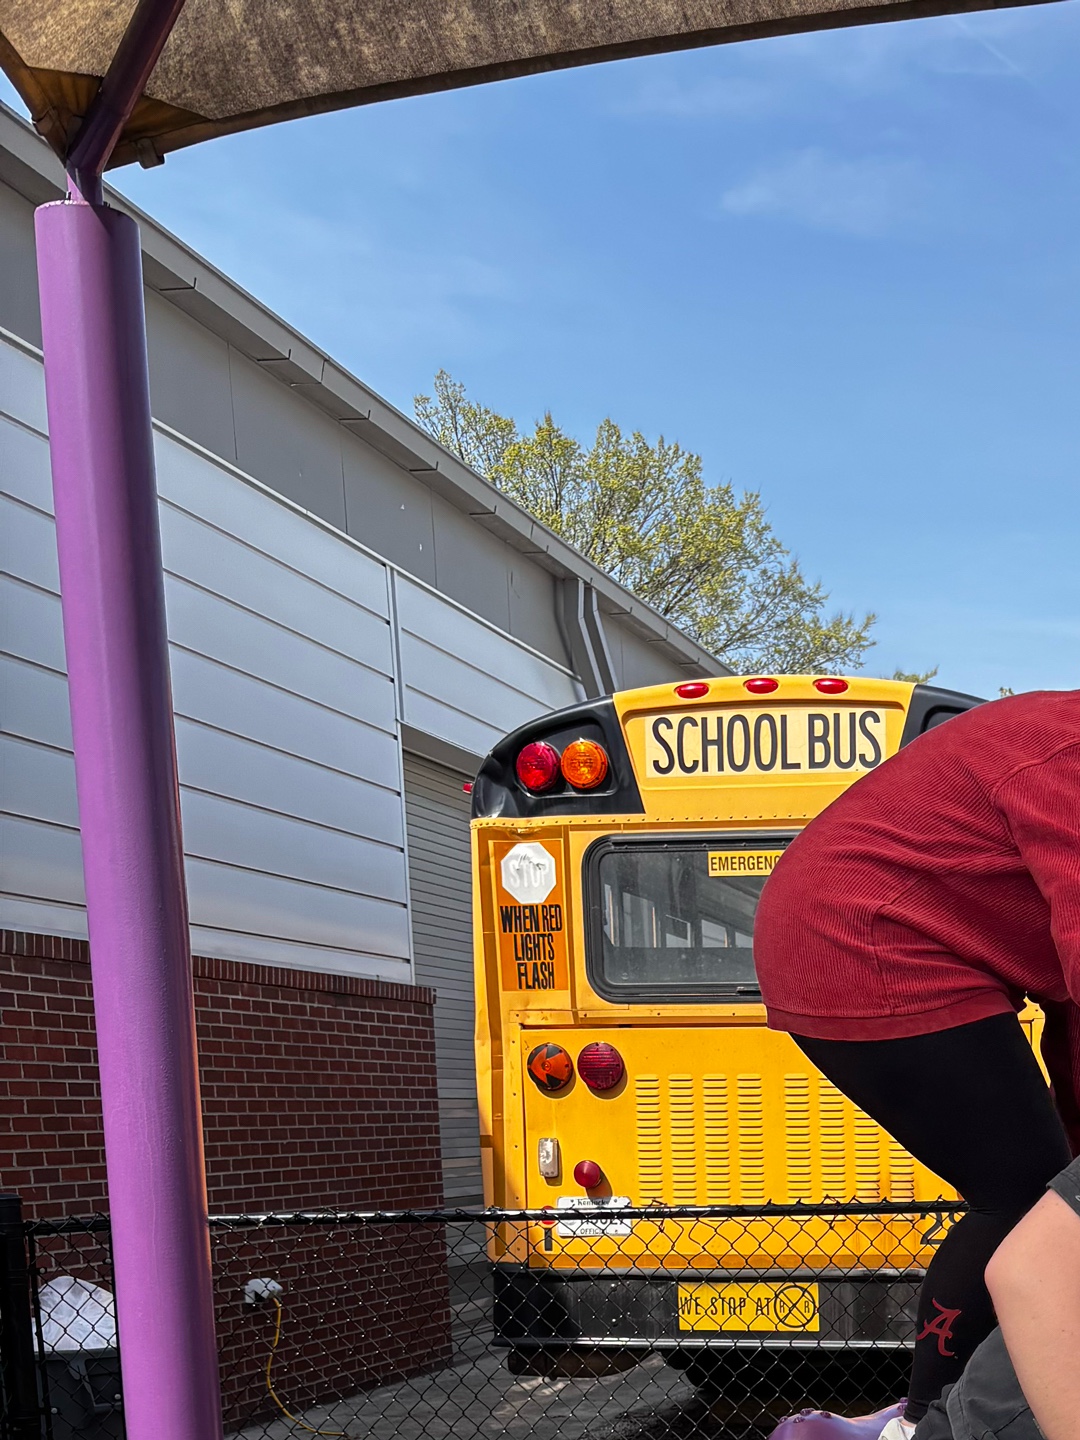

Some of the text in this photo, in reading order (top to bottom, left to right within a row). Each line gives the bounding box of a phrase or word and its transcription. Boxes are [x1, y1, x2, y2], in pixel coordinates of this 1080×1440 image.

[652, 710, 882, 775] SCHOOL BUS
[710, 854, 782, 871] EMERGEN
[500, 904, 563, 934] WHEN RED
[513, 933, 555, 962] LIGHTS
[516, 961, 555, 990] FLASH
[679, 1296, 701, 1316] WE
[710, 1296, 747, 1316] STOP
[756, 1296, 772, 1316] AT
[915, 1297, 962, 1357] A
